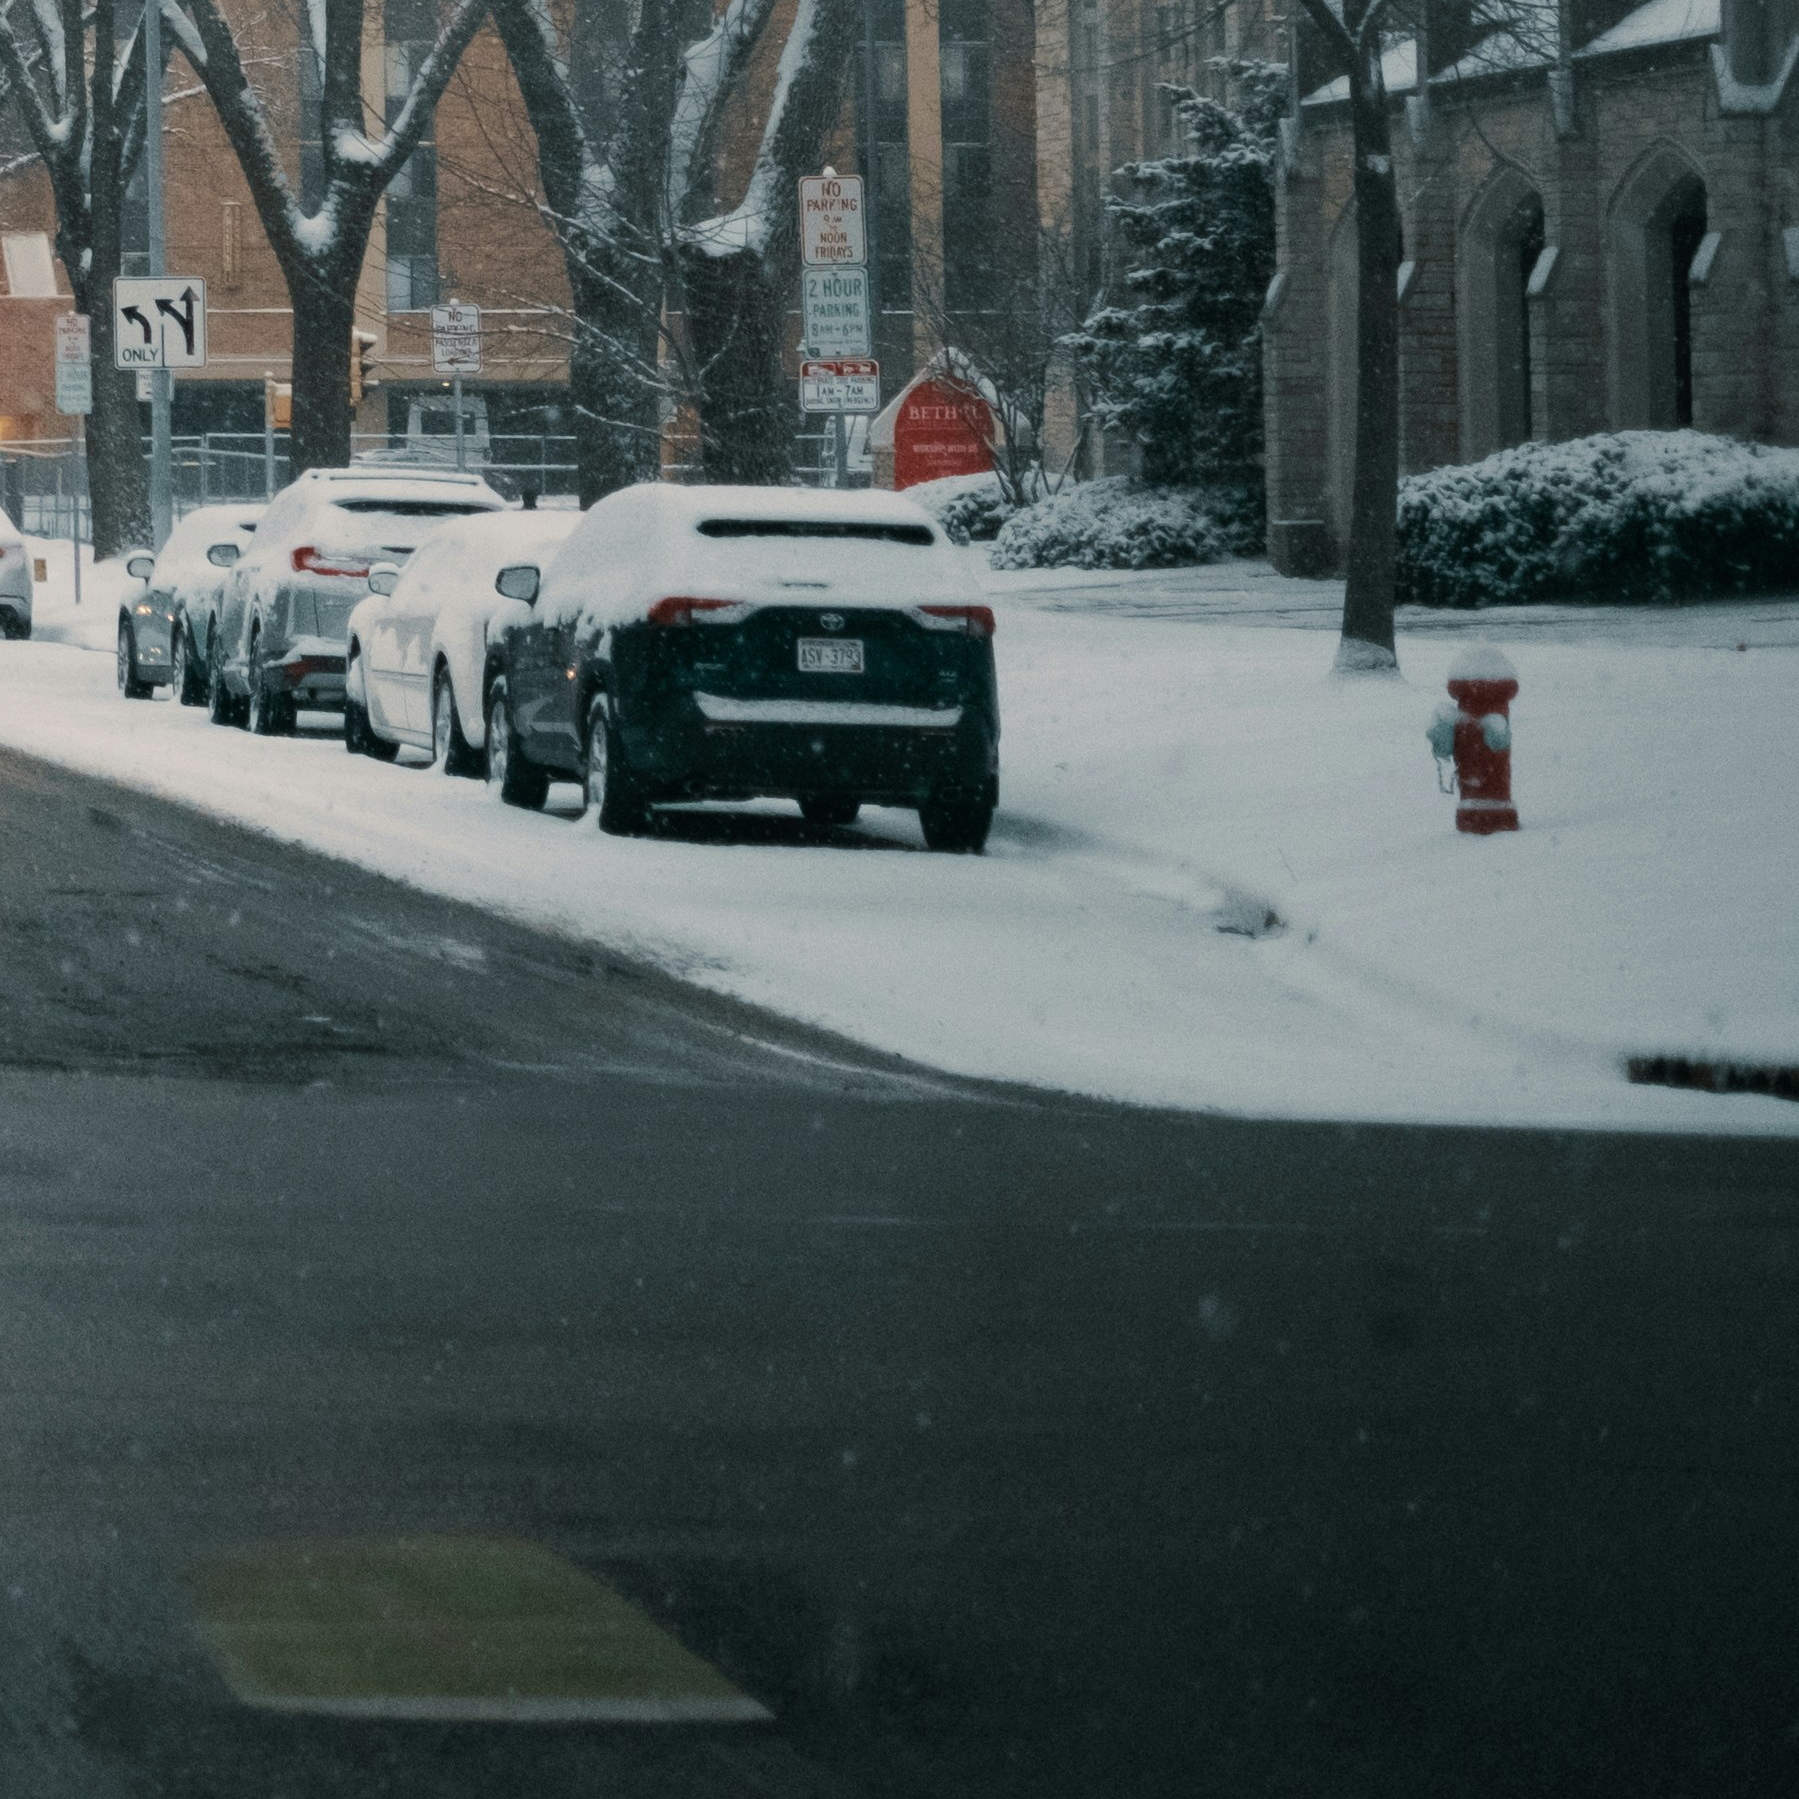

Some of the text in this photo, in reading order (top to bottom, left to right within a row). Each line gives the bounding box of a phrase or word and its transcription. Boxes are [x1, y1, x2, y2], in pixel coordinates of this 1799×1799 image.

[821, 181, 842, 197] NO
[806, 199, 858, 212] PARKING
[820, 232, 848, 243] NOON
[815, 246, 853, 259] FRIDAYS
[808, 278, 863, 297] 2 HOUR
[813, 303, 859, 318] PARKING
[122, 348, 159, 361] ONLY
[909, 406, 983, 420] BETHL
